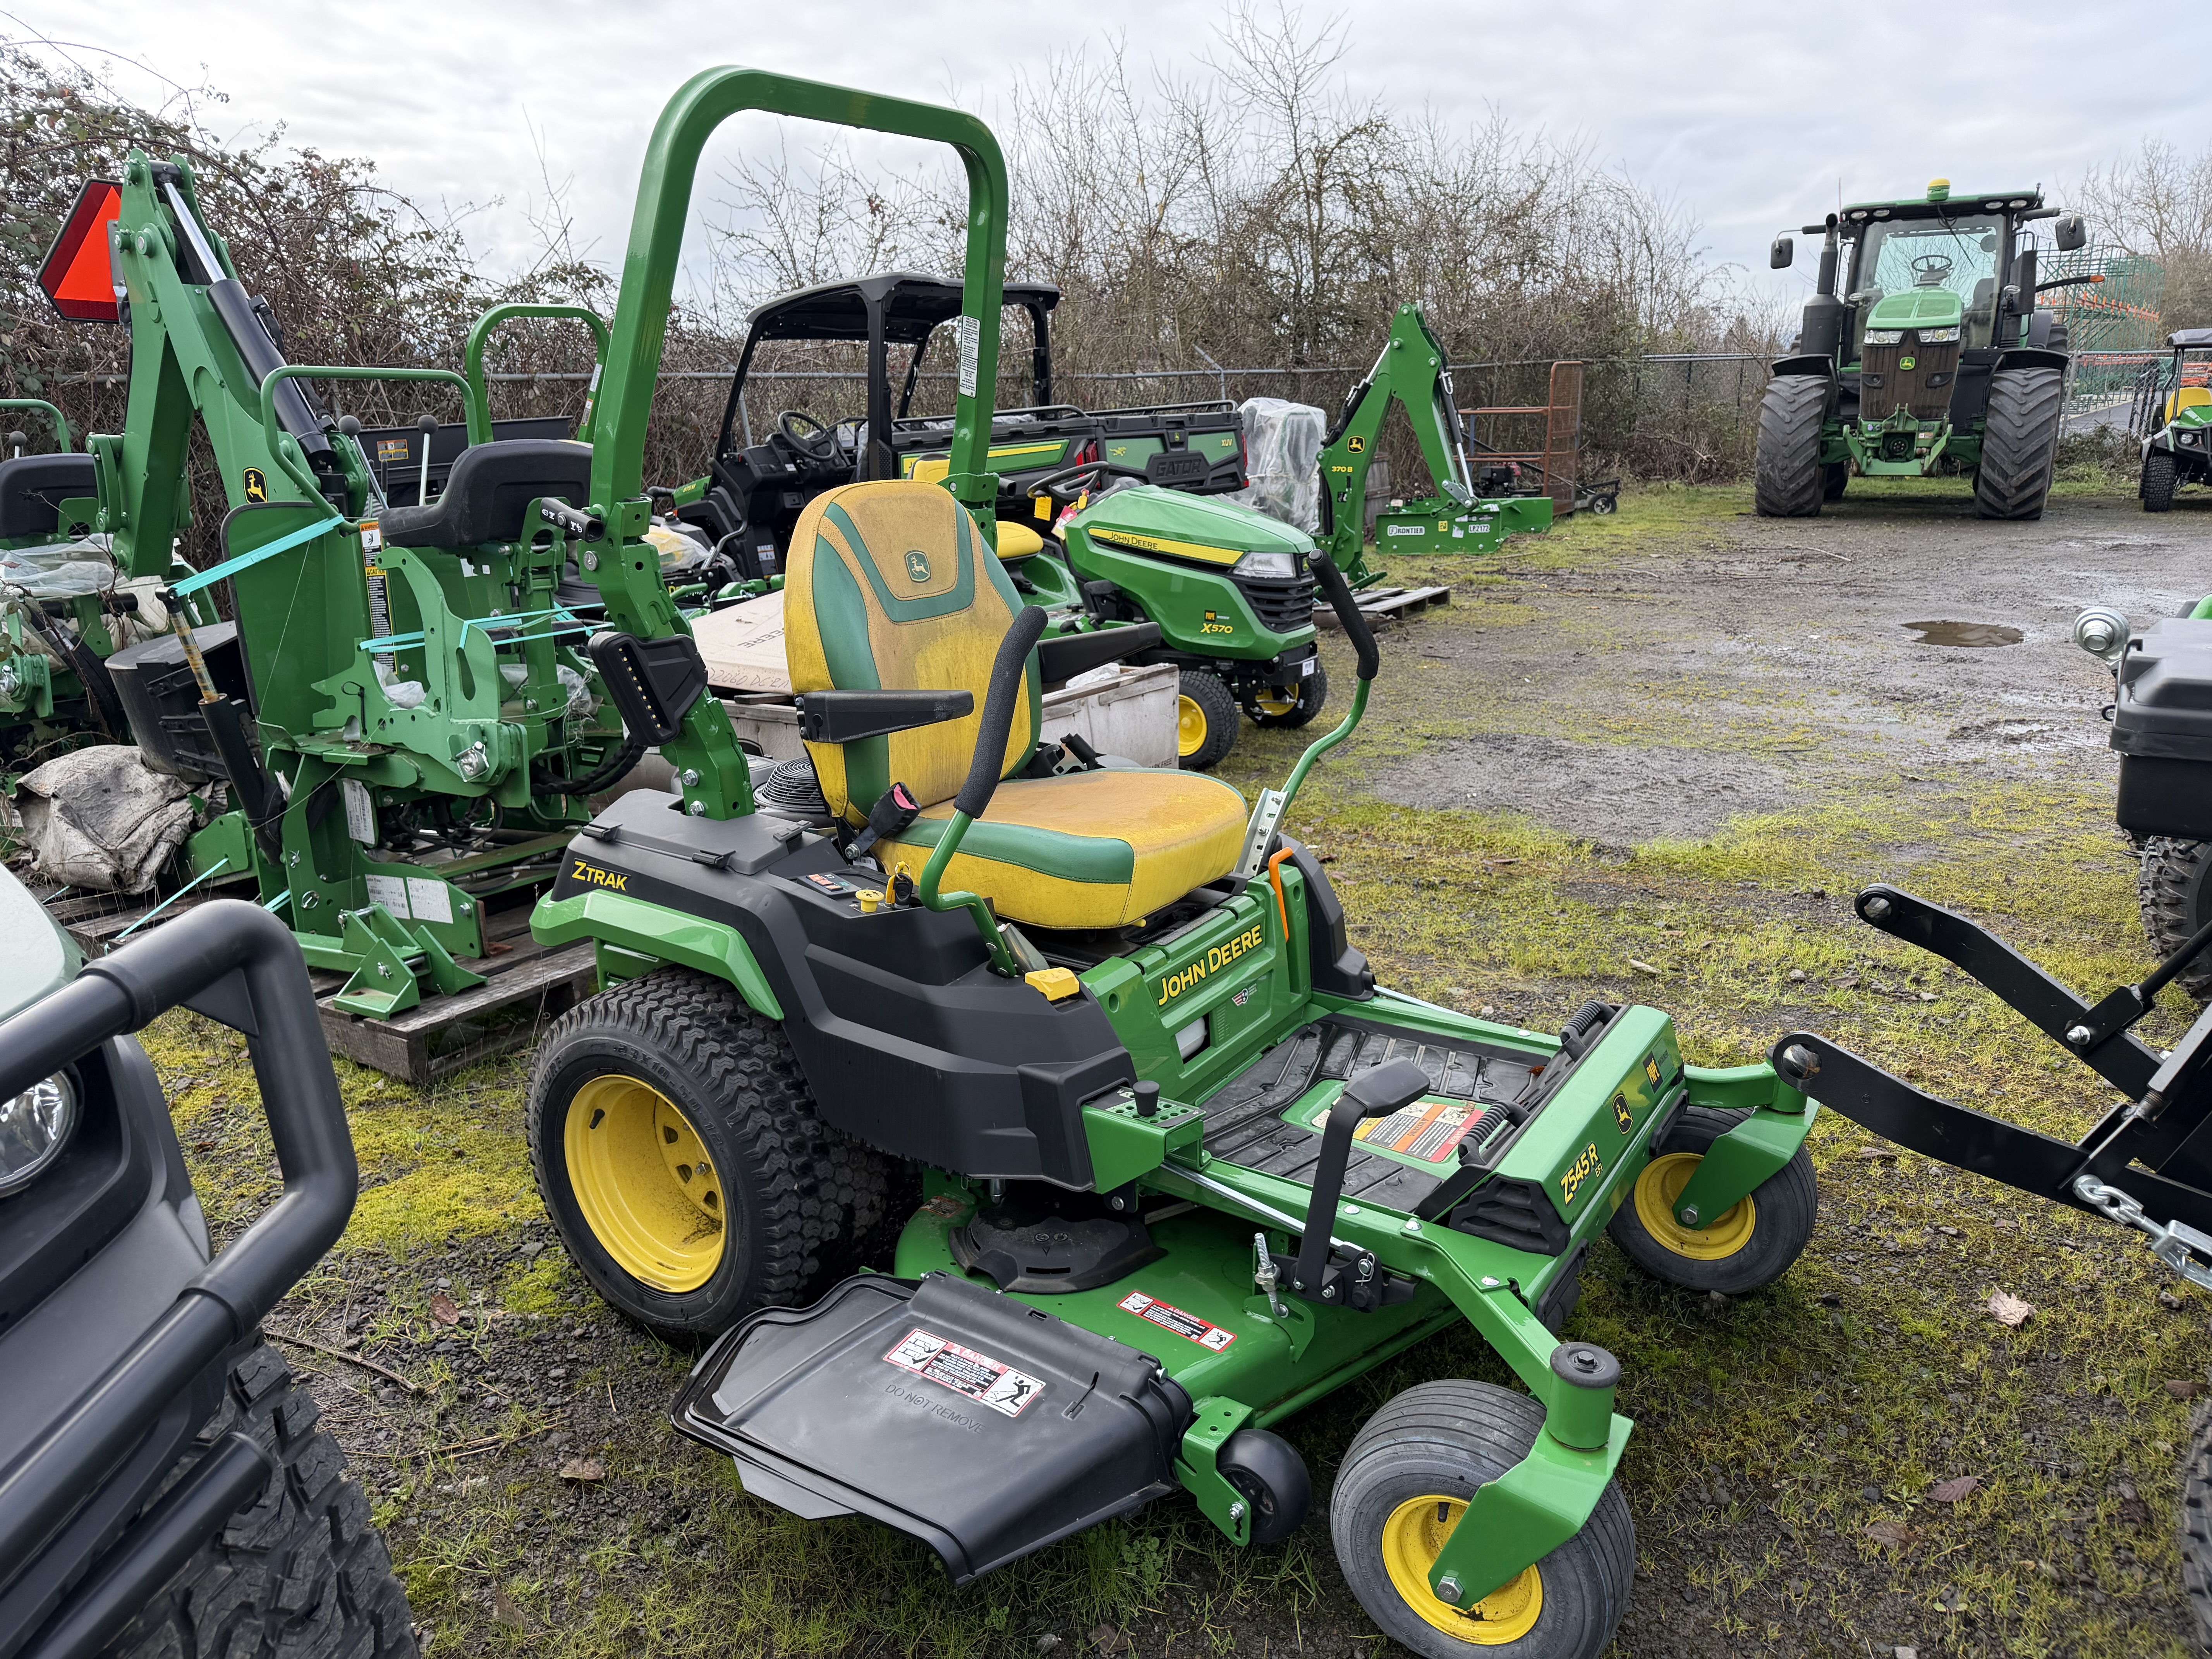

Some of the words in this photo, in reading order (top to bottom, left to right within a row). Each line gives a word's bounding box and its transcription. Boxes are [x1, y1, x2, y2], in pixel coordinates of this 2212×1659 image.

[1156, 459, 1201, 478] GATOR
[1389, 526, 1423, 535] FRONTIER
[1109, 532, 1130, 543] JOHN
[1131, 537, 1158, 550] DEERE
[1200, 623, 1233, 634] X570
[737, 628, 785, 648] EERE
[1161, 757, 1172, 768] FREE
[572, 860, 628, 891] ZTRAK
[1159, 958, 1206, 1006] JOHN
[1207, 924, 1262, 974] DEERE
[540, 1055, 563, 1093] TURF
[1365, 1118, 1378, 1127] TION
[1407, 1120, 1426, 1137] WARNING
[1446, 1129, 1465, 1145] DANGER
[1595, 1163, 1604, 1177] EFI
[1173, 1308, 1201, 1323] DANGER
[950, 1353, 974, 1365] ROTATING
[962, 1348, 1002, 1370] DANGER
[942, 1360, 963, 1371] THROWN
[963, 1369, 985, 1380] OBJECTS
[884, 1384, 905, 1396] DO
[904, 1392, 933, 1408] NOT
[931, 1404, 986, 1434] REMOVE
[1356, 1530, 1365, 1559] RATING
